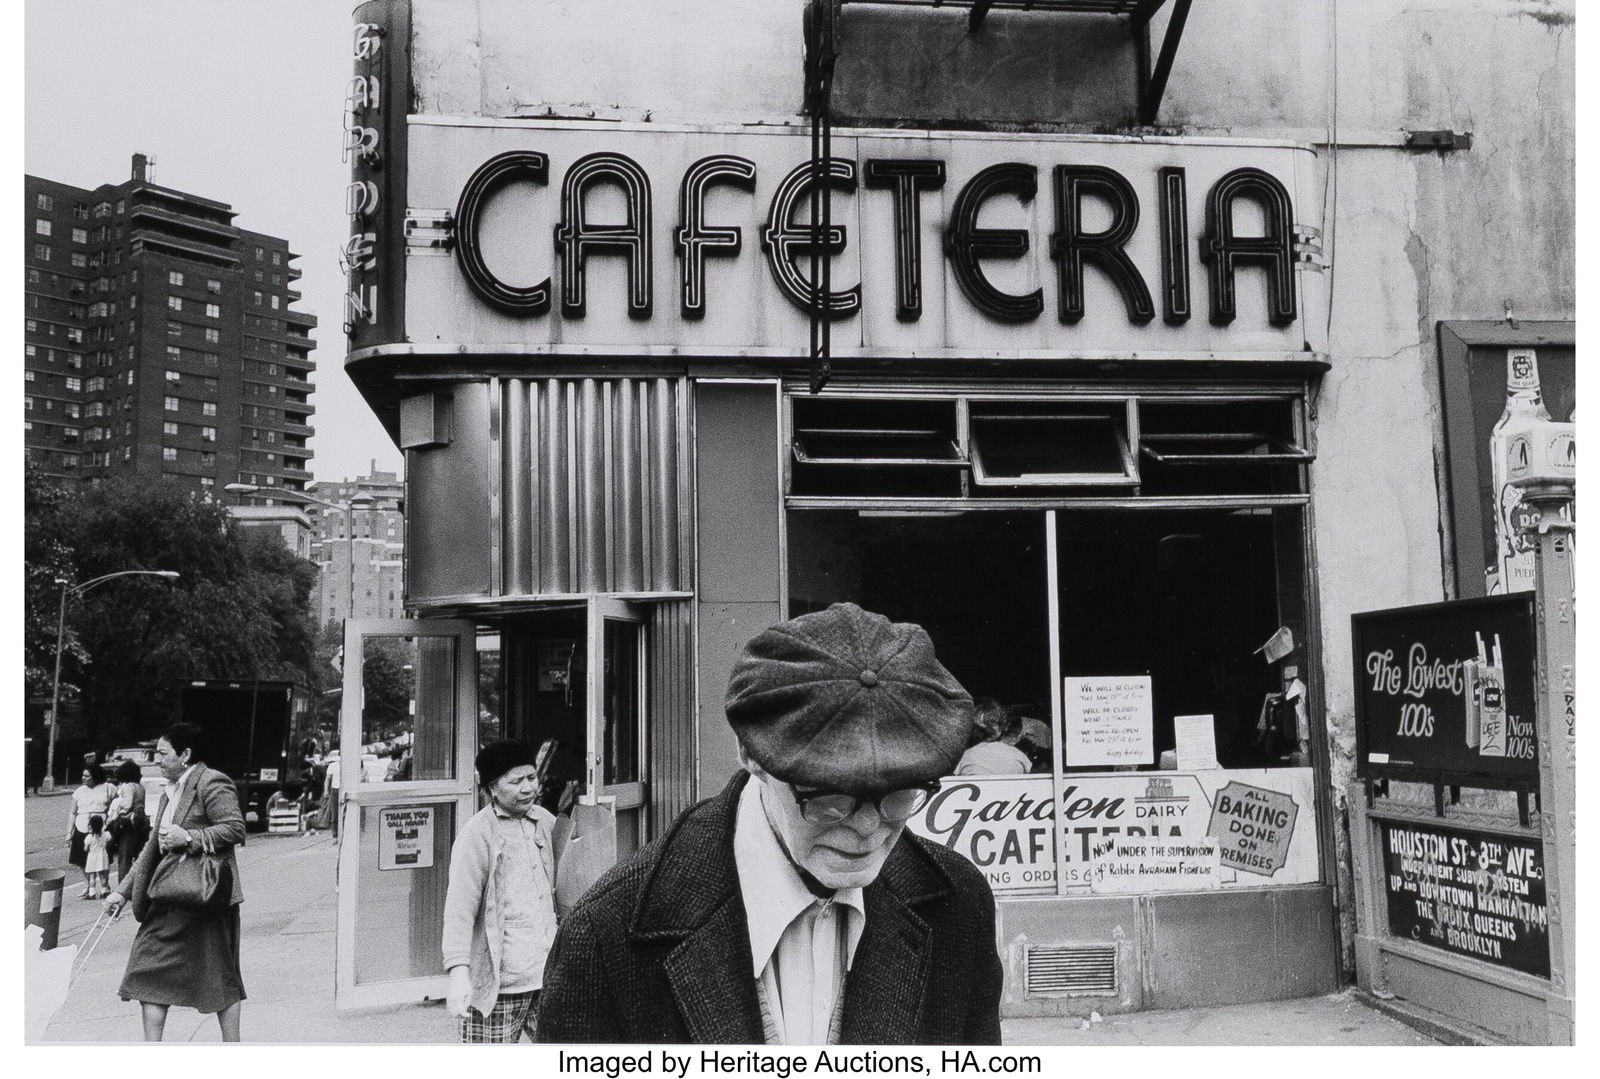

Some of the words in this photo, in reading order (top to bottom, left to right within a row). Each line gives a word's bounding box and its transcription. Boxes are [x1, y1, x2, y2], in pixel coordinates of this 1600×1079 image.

[453, 150, 1296, 325] CAFETERIA
[1366, 649, 1402, 695] The
[1403, 642, 1463, 698] Lowest
[1397, 703, 1435, 737] 100's
[1507, 715, 1534, 736] Now
[1564, 694, 1575, 736] DAVE
[1506, 737, 1535, 759] 100's
[1244, 790, 1269, 802] ALL
[385, 812, 412, 821] THANK
[414, 811, 430, 820] YOU
[925, 783, 1126, 850] Garden
[1136, 805, 1188, 818] DAIRY
[1218, 795, 1288, 829] BAKING
[1229, 820, 1275, 843] DONE
[1238, 839, 1257, 851] ON
[1093, 838, 1114, 859] NOW
[1117, 846, 1147, 857] UNDER
[1151, 846, 1165, 857] THE
[1168, 846, 1215, 857] SUPERVISION
[1389, 828, 1448, 863] HOUSTON
[1451, 837, 1469, 866] ST
[1094, 863, 1107, 882] of
[1109, 863, 1135, 875] Rabbi
[1138, 863, 1177, 875] AVRAHAM
[1390, 874, 1402, 892] UP
[1404, 881, 1417, 893] AND
[1419, 882, 1475, 909] DOWNTOWN
[1477, 892, 1548, 926] MANHATTAN
[1415, 900, 1434, 920] THE
[1474, 913, 1517, 942] QUEENS
[1446, 928, 1502, 960] BROOKLYN
